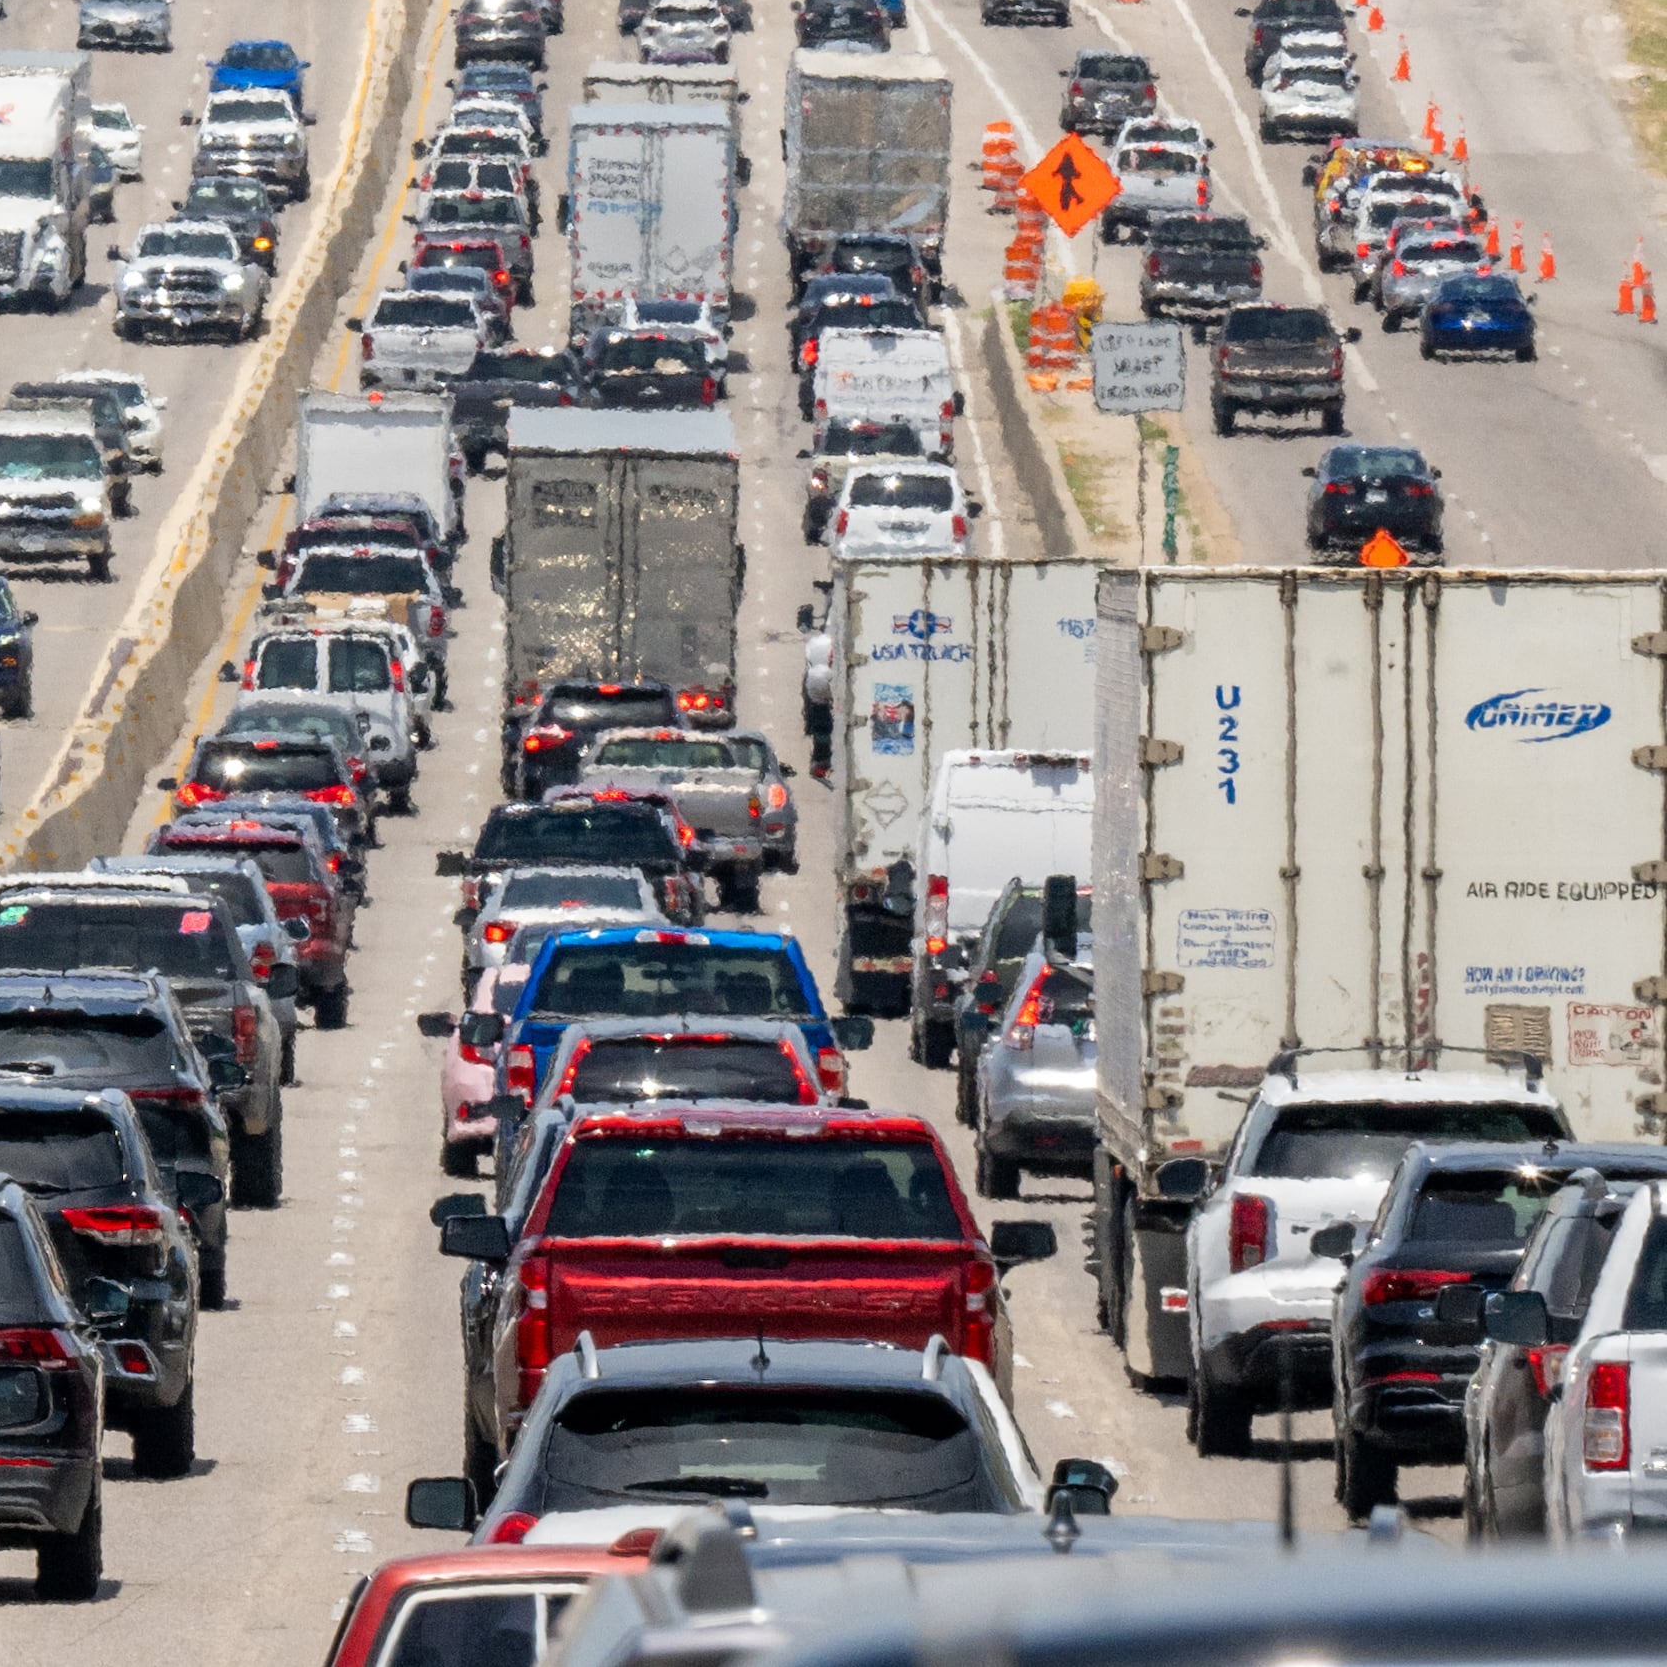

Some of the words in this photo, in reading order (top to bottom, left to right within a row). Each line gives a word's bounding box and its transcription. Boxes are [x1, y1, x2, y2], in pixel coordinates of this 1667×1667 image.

[1215, 685, 1241, 805] U231
[1467, 882, 1498, 899] AIR
[1505, 881, 1550, 899] RIDE
[1557, 881, 1657, 902] EQUIPPED
[1465, 966, 1493, 982] HOW
[1496, 966, 1514, 982] AM
[1572, 1005, 1652, 1020] CAUTON
